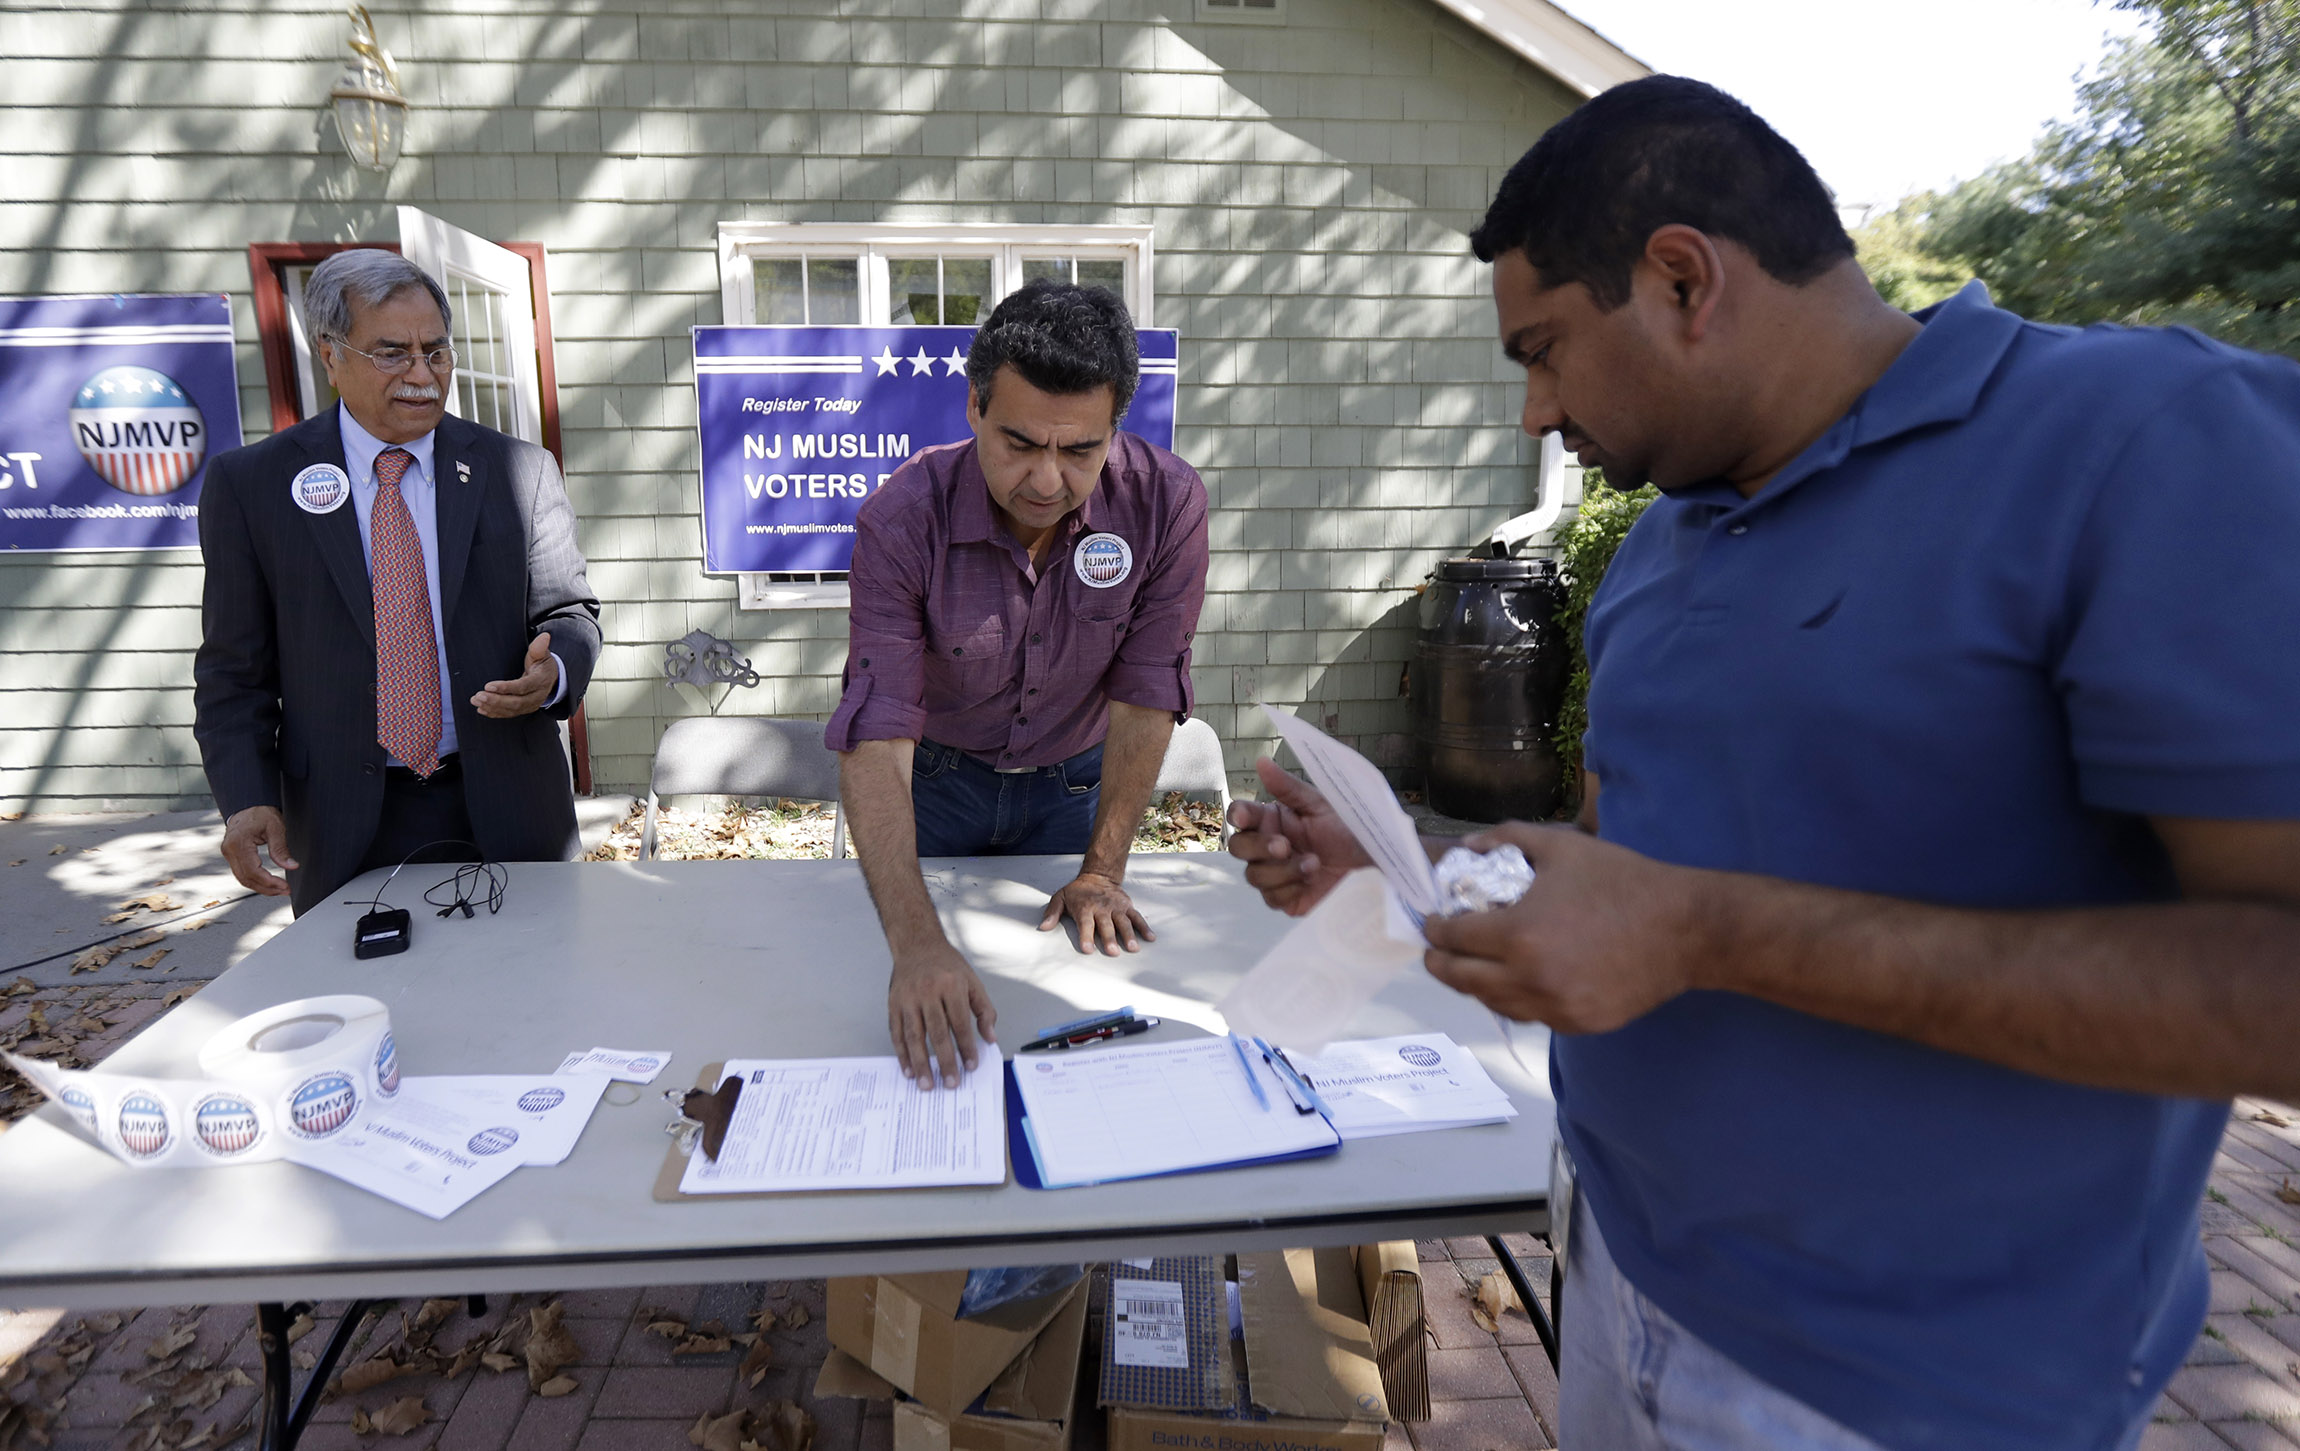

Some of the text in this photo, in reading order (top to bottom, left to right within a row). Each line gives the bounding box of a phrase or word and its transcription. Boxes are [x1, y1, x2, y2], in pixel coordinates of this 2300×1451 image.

[742, 397, 862, 415] Register Today
[77, 420, 201, 448] NJMVP
[743, 432, 910, 459] NJ MUSLIM
[302, 483, 339, 495] NJMVP
[743, 473, 868, 499] VOTERS
[1084, 556, 1122, 567] NJMVP
[1330, 1075, 1375, 1087] Muslim
[1374, 1071, 1411, 1082] Voters
[1410, 1067, 1449, 1079] Project
[294, 1091, 353, 1122] NJMVP
[120, 1119, 167, 1133] NJMVP
[199, 1119, 256, 1134] NJMVP
[409, 1136, 441, 1157] Voters
[438, 1150, 479, 1170] Project
[1151, 1431, 1199, 1448] Bath
[1200, 1434, 1214, 1448] &
[1218, 1437, 1271, 1451] Body
